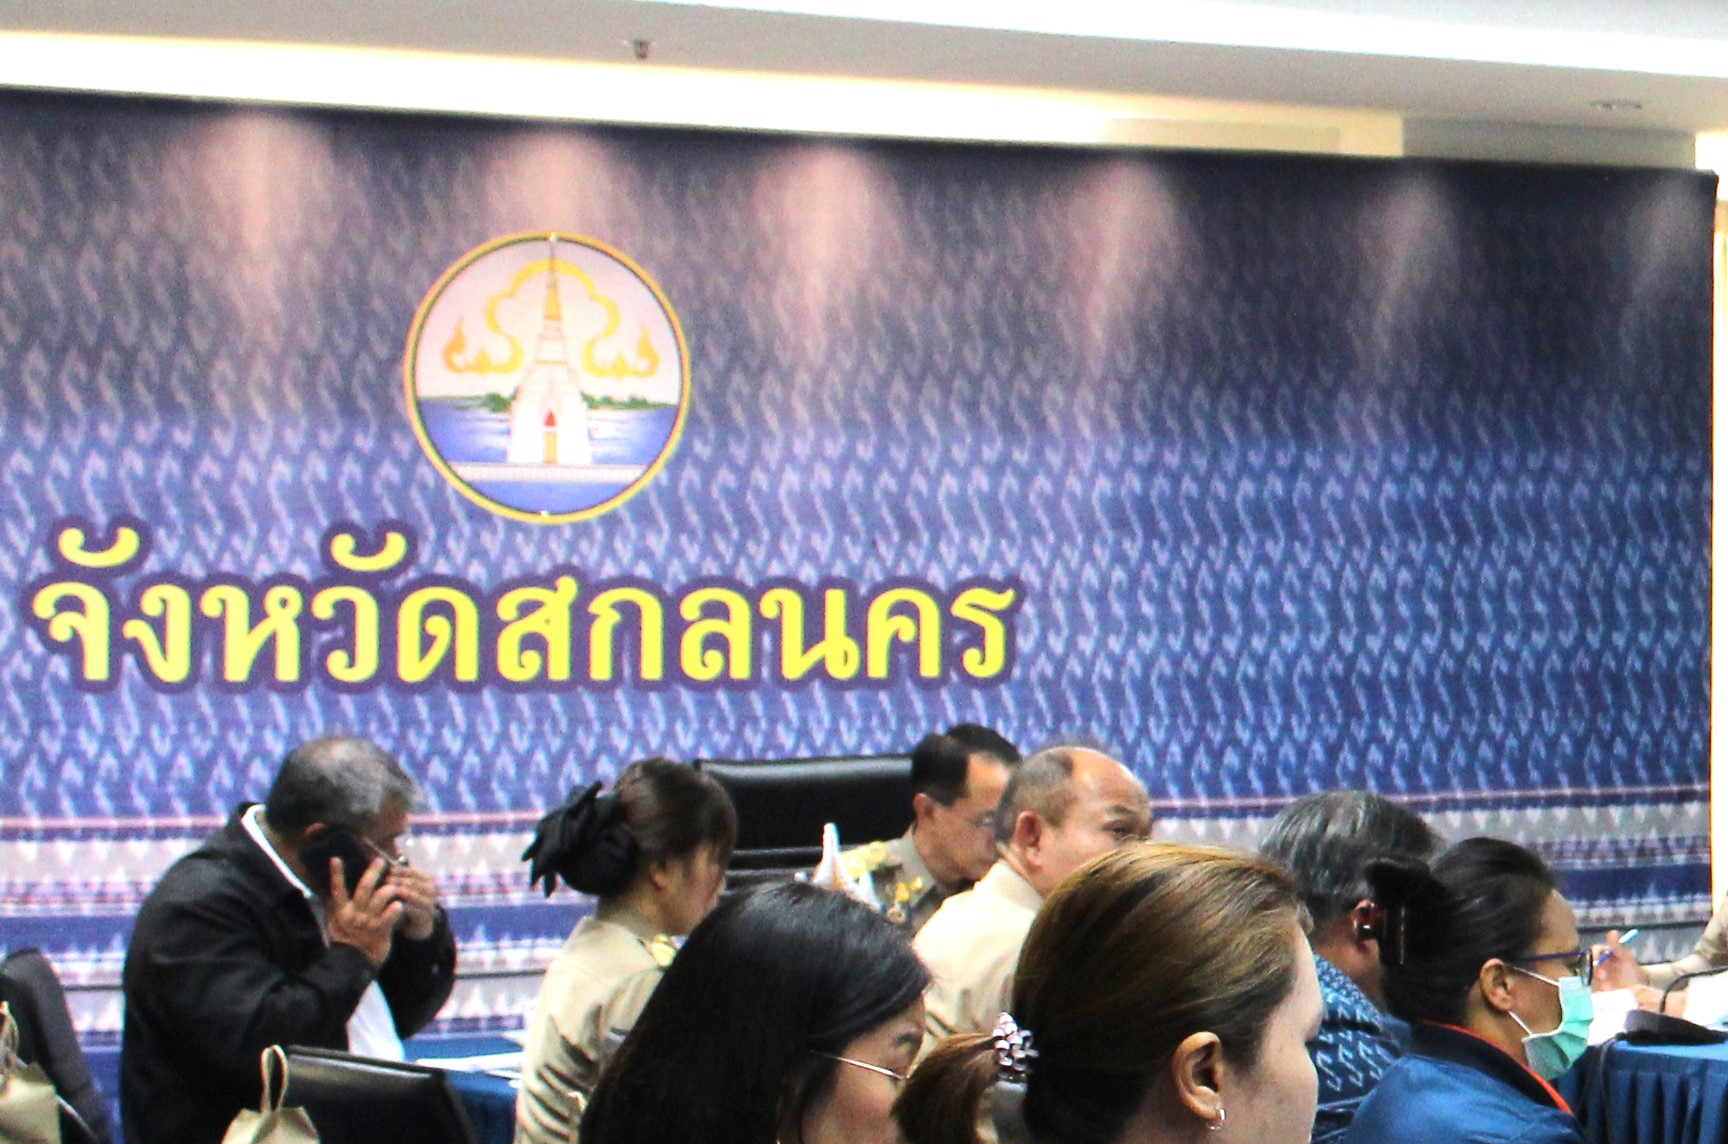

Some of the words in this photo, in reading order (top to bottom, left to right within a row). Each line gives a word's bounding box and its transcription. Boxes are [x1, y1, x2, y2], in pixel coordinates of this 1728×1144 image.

[33, 525, 1017, 684] จังหวัดสกลนคร
